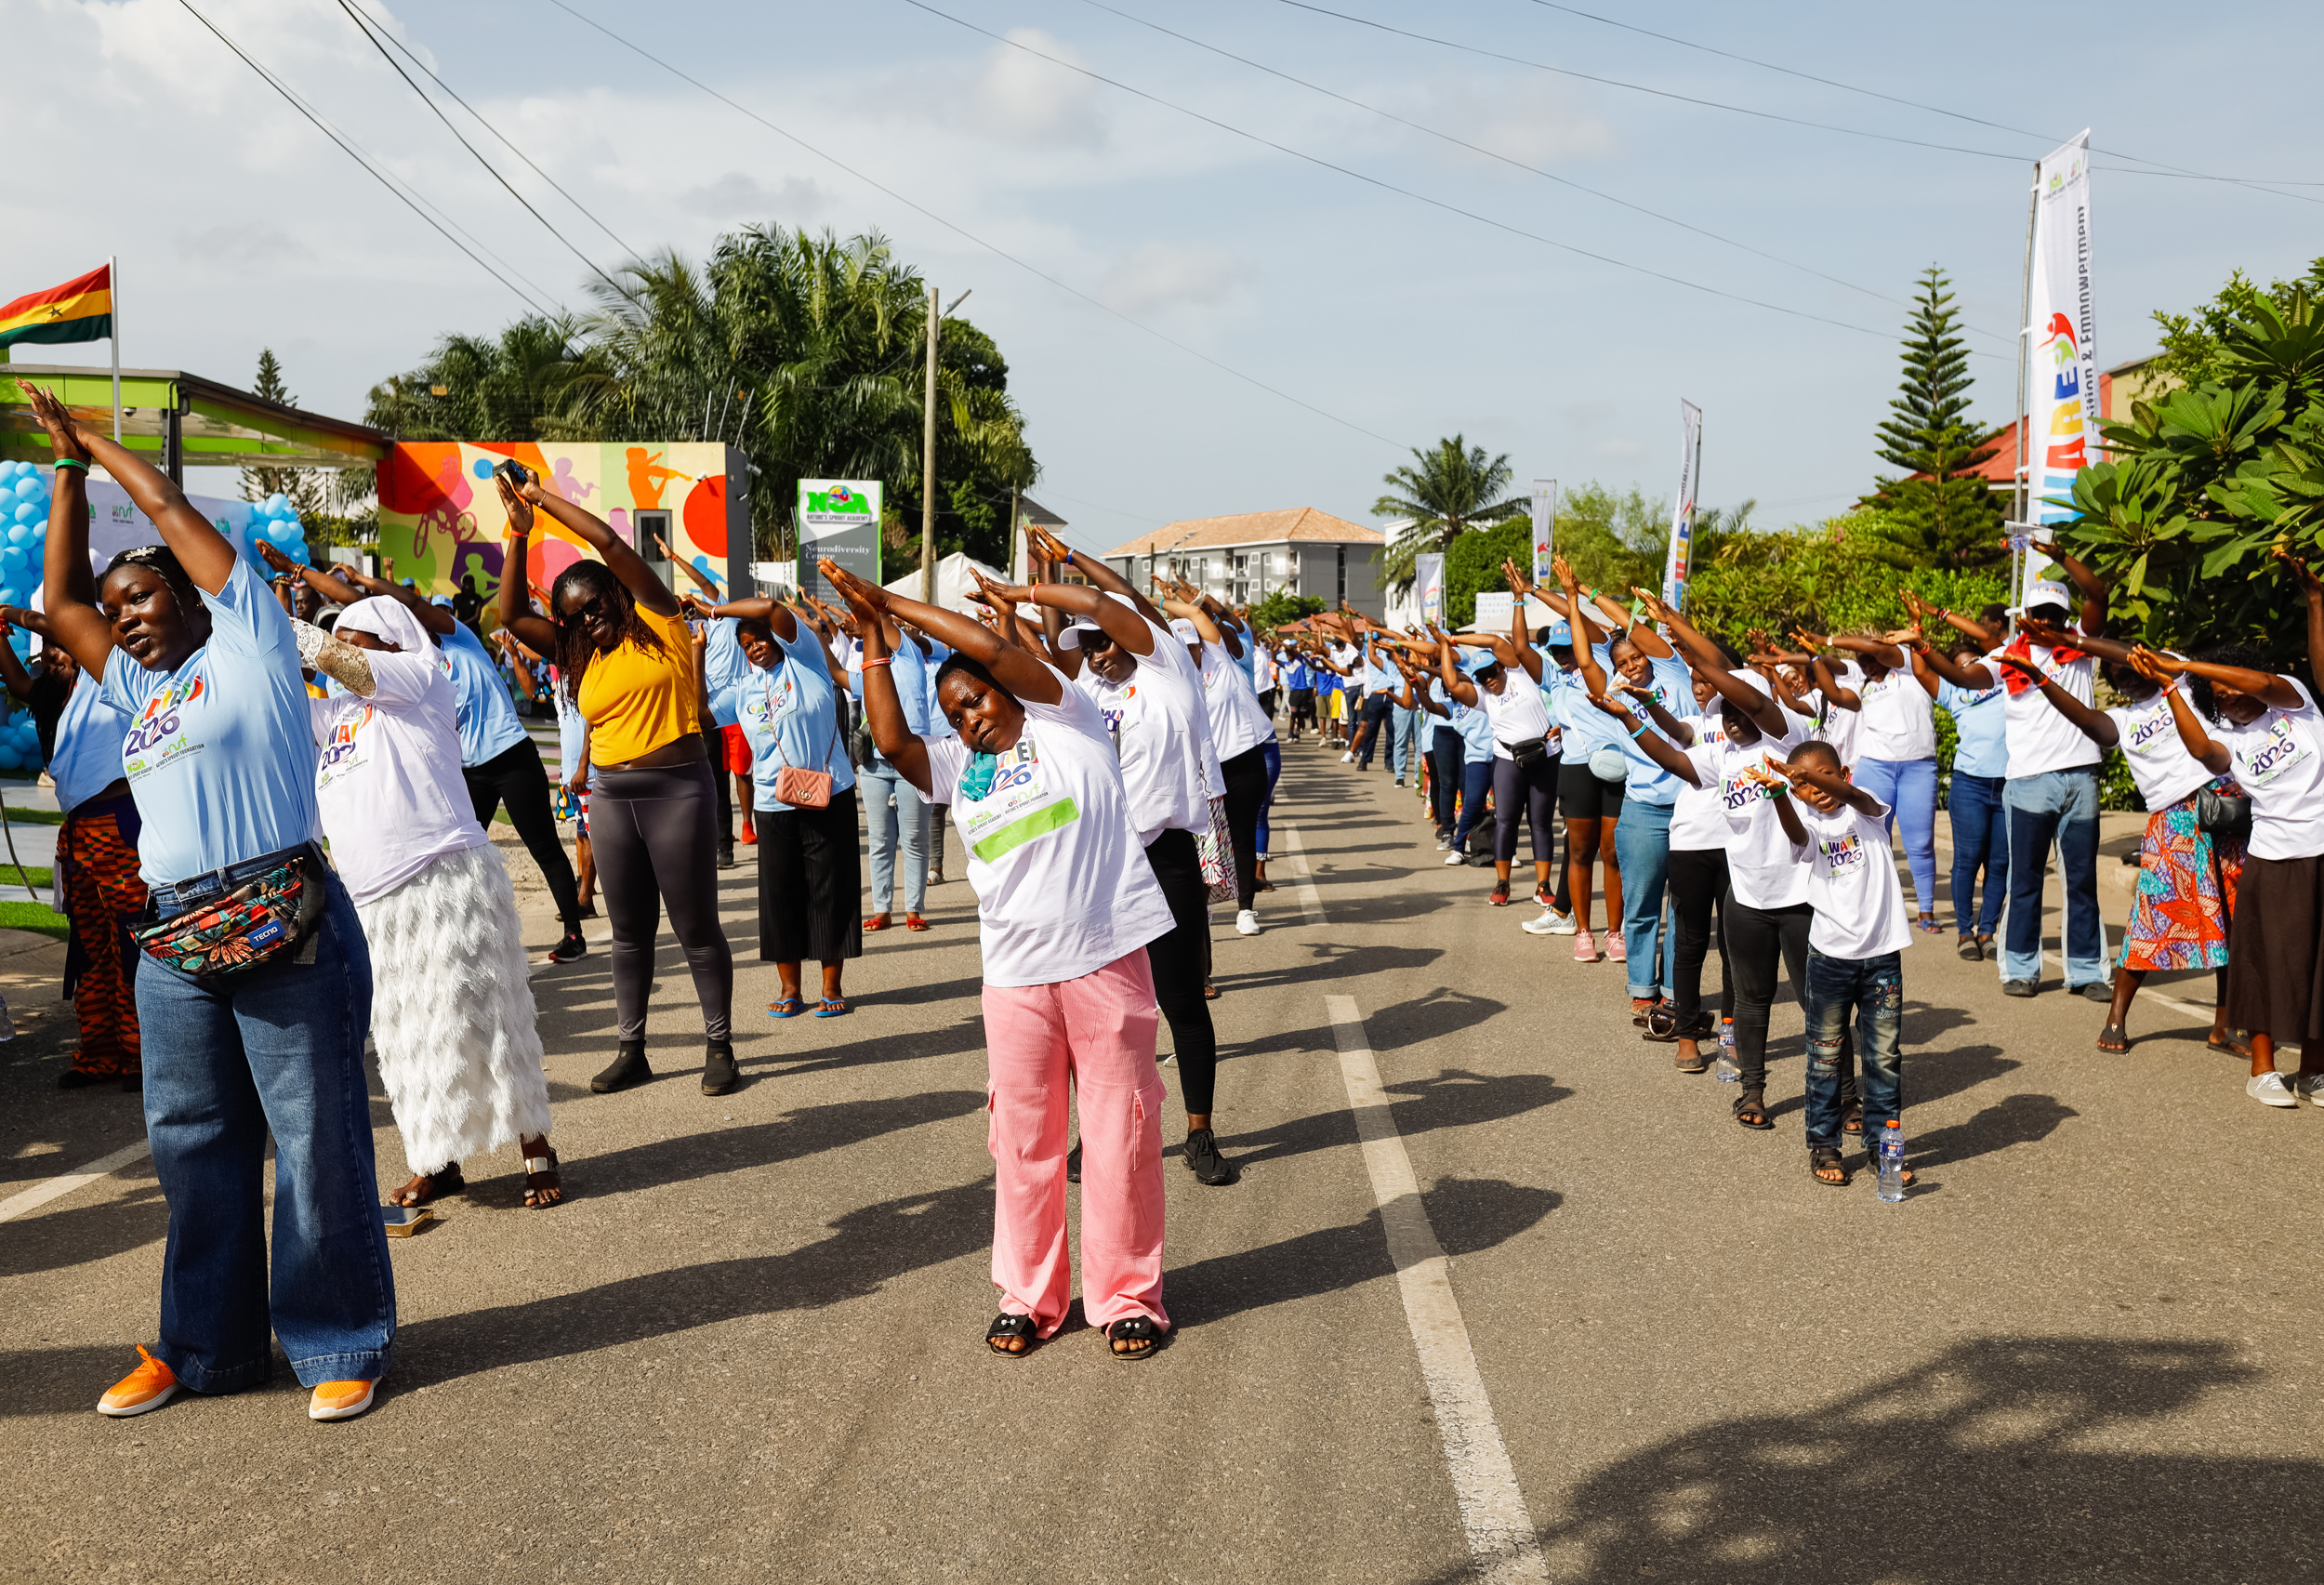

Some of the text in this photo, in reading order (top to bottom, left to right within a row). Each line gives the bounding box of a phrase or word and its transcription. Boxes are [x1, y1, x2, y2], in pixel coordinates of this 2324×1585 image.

[805, 544, 870, 555] Neurodiversity
[2130, 712, 2173, 746] 2026
[2250, 737, 2295, 776] 2026
[1828, 848, 1863, 868] 2026
[253, 926, 278, 942] TECNO
